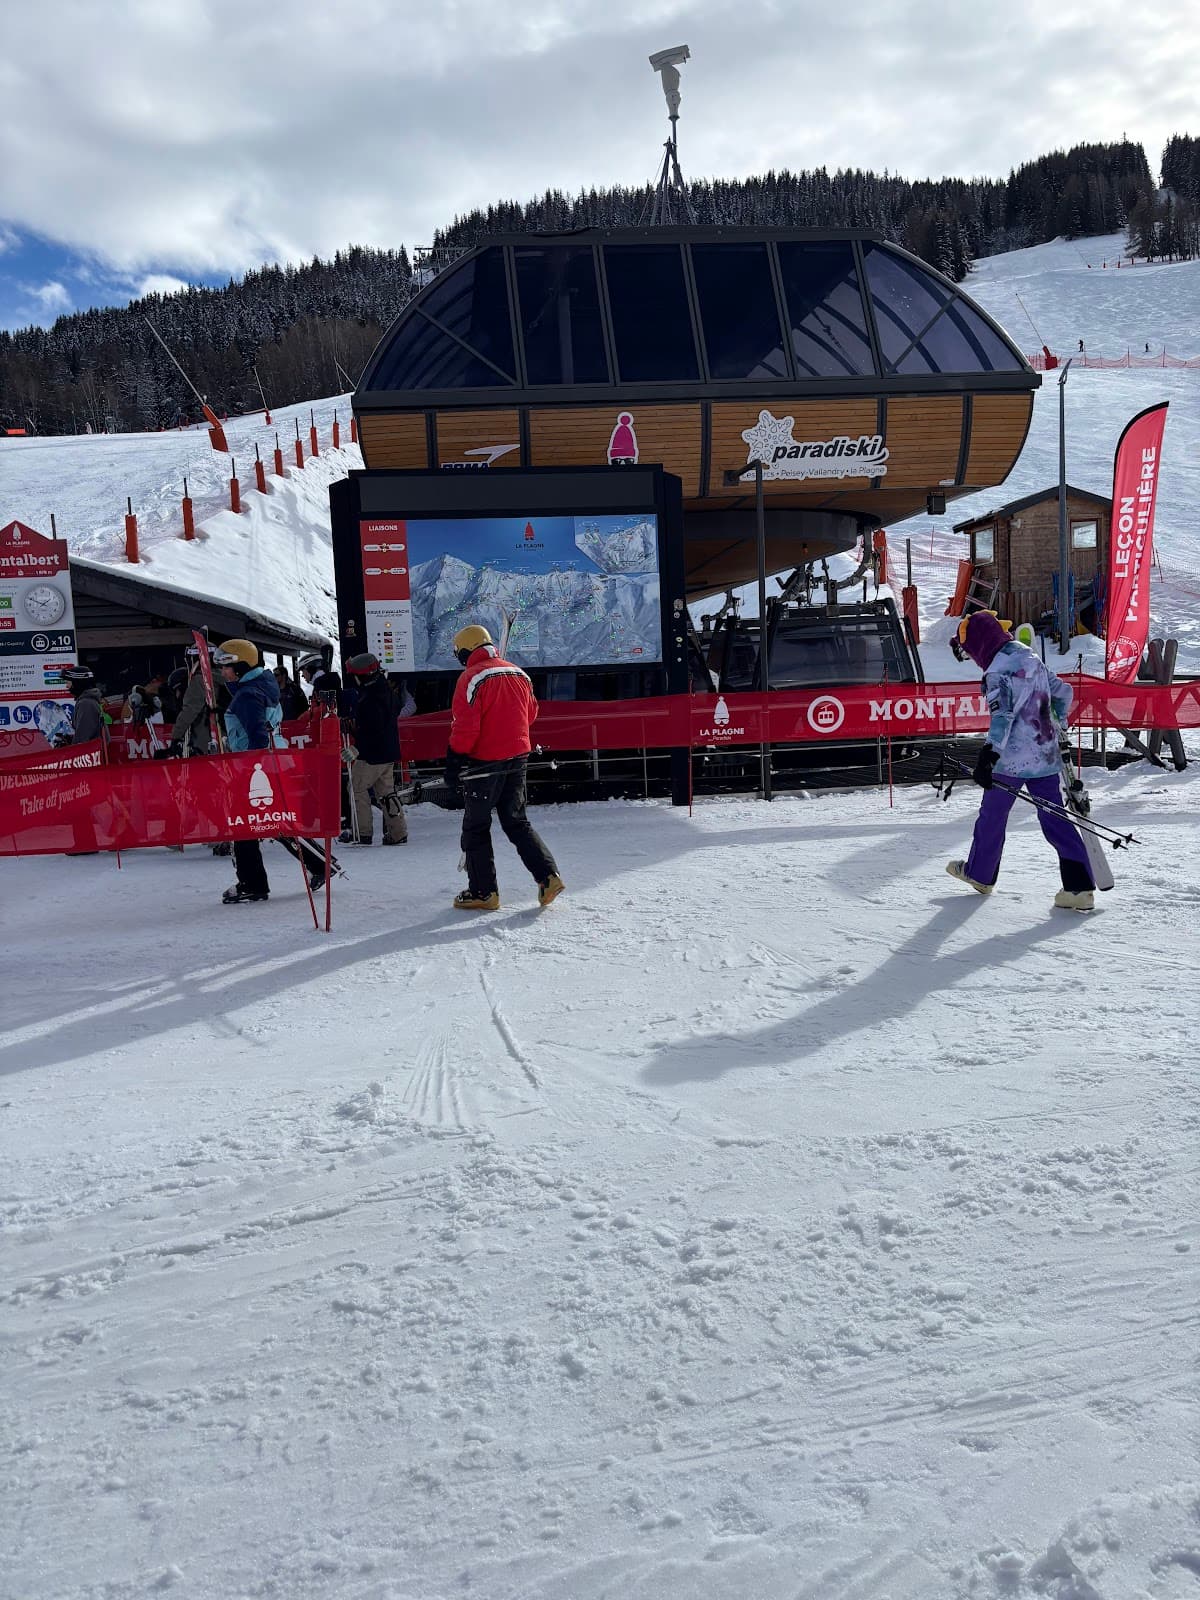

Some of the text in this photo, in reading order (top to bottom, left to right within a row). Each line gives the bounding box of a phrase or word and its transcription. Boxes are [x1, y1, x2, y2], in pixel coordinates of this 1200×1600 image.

[771, 439, 879, 463] paradiski
[859, 467, 884, 476] Plagne
[1115, 497, 1135, 579] LEÇON
[712, 727, 745, 736] PLAGNE
[20, 780, 91, 816] Take off your skis
[227, 811, 297, 826] LA PLAGNE
